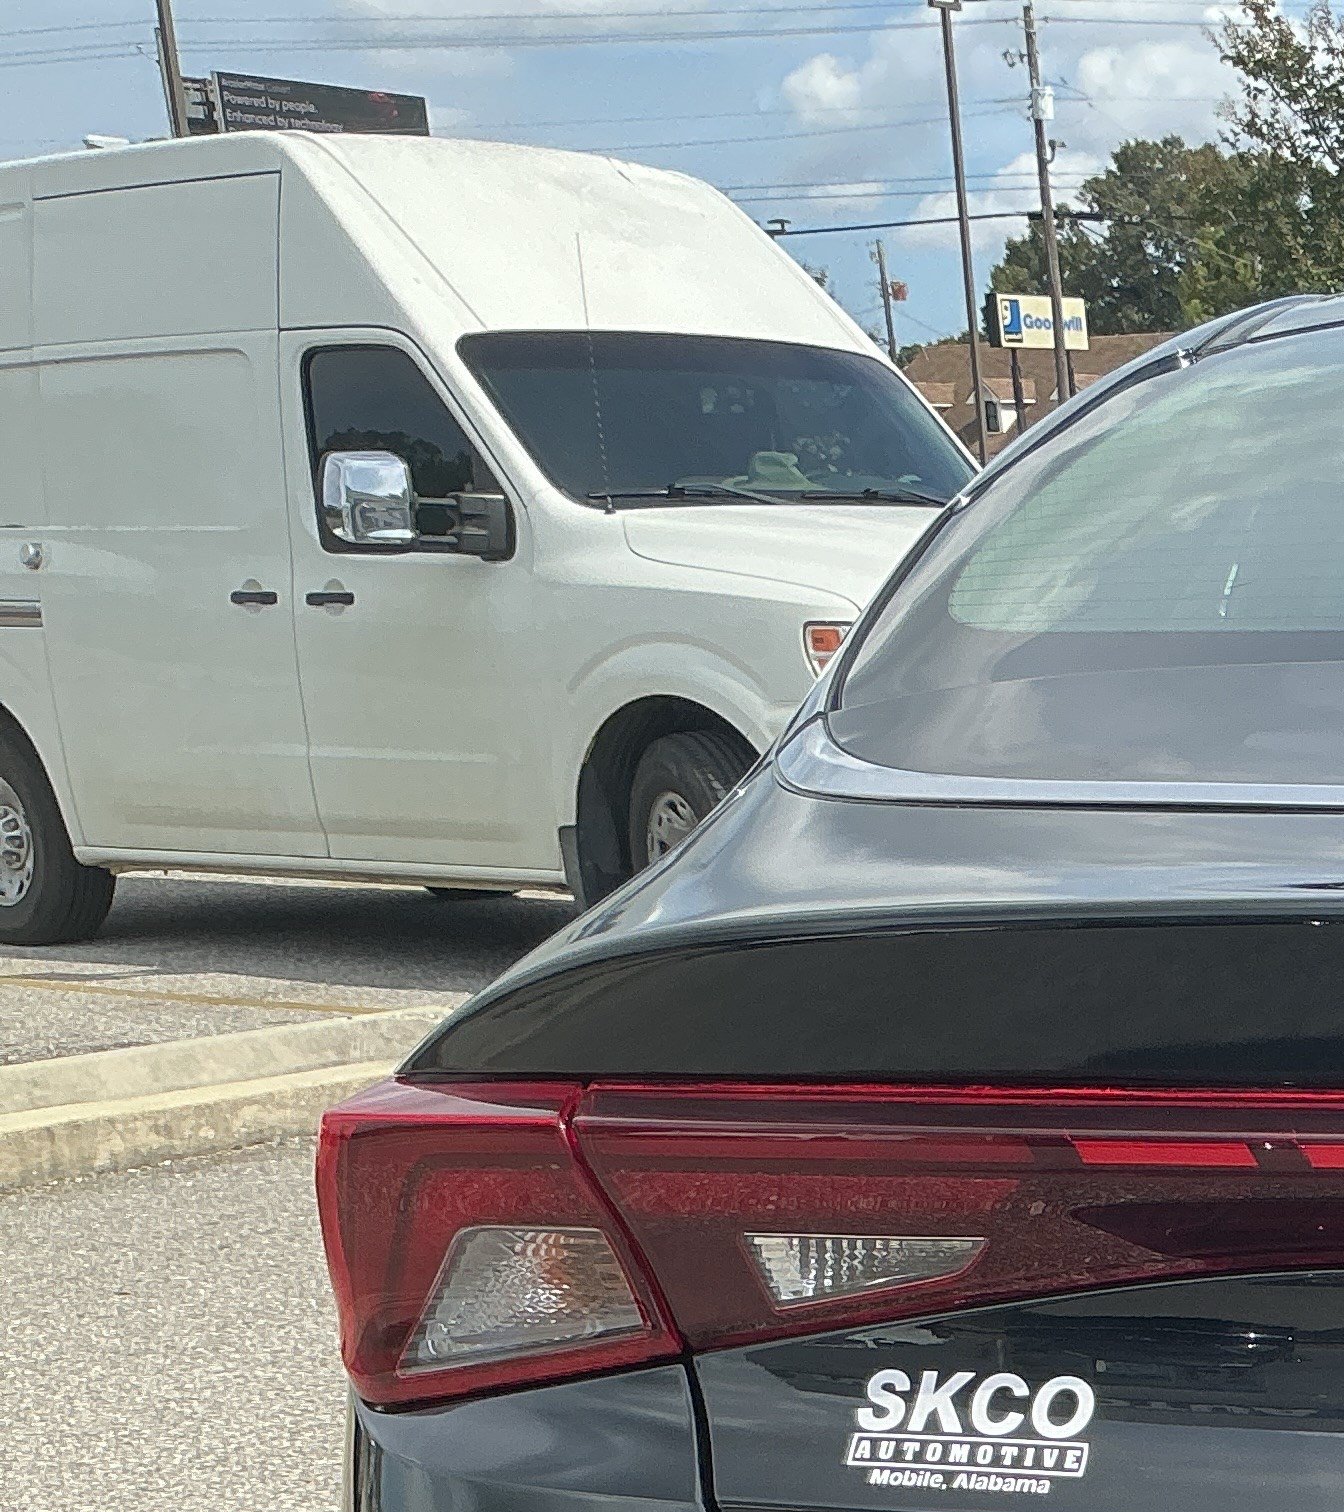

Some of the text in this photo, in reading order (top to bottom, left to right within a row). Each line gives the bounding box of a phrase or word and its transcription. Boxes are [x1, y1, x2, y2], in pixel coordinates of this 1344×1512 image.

[223, 91, 267, 108] Powered
[267, 97, 281, 112] by
[226, 109, 275, 126] Enhanced
[276, 115, 289, 129] by
[1023, 313, 1082, 331] Goowill
[856, 1369, 1095, 1439] SKCO
[855, 1440, 1082, 1470] AUTOMOTIVE
[869, 1469, 1051, 1494] Mobile, Alabama
